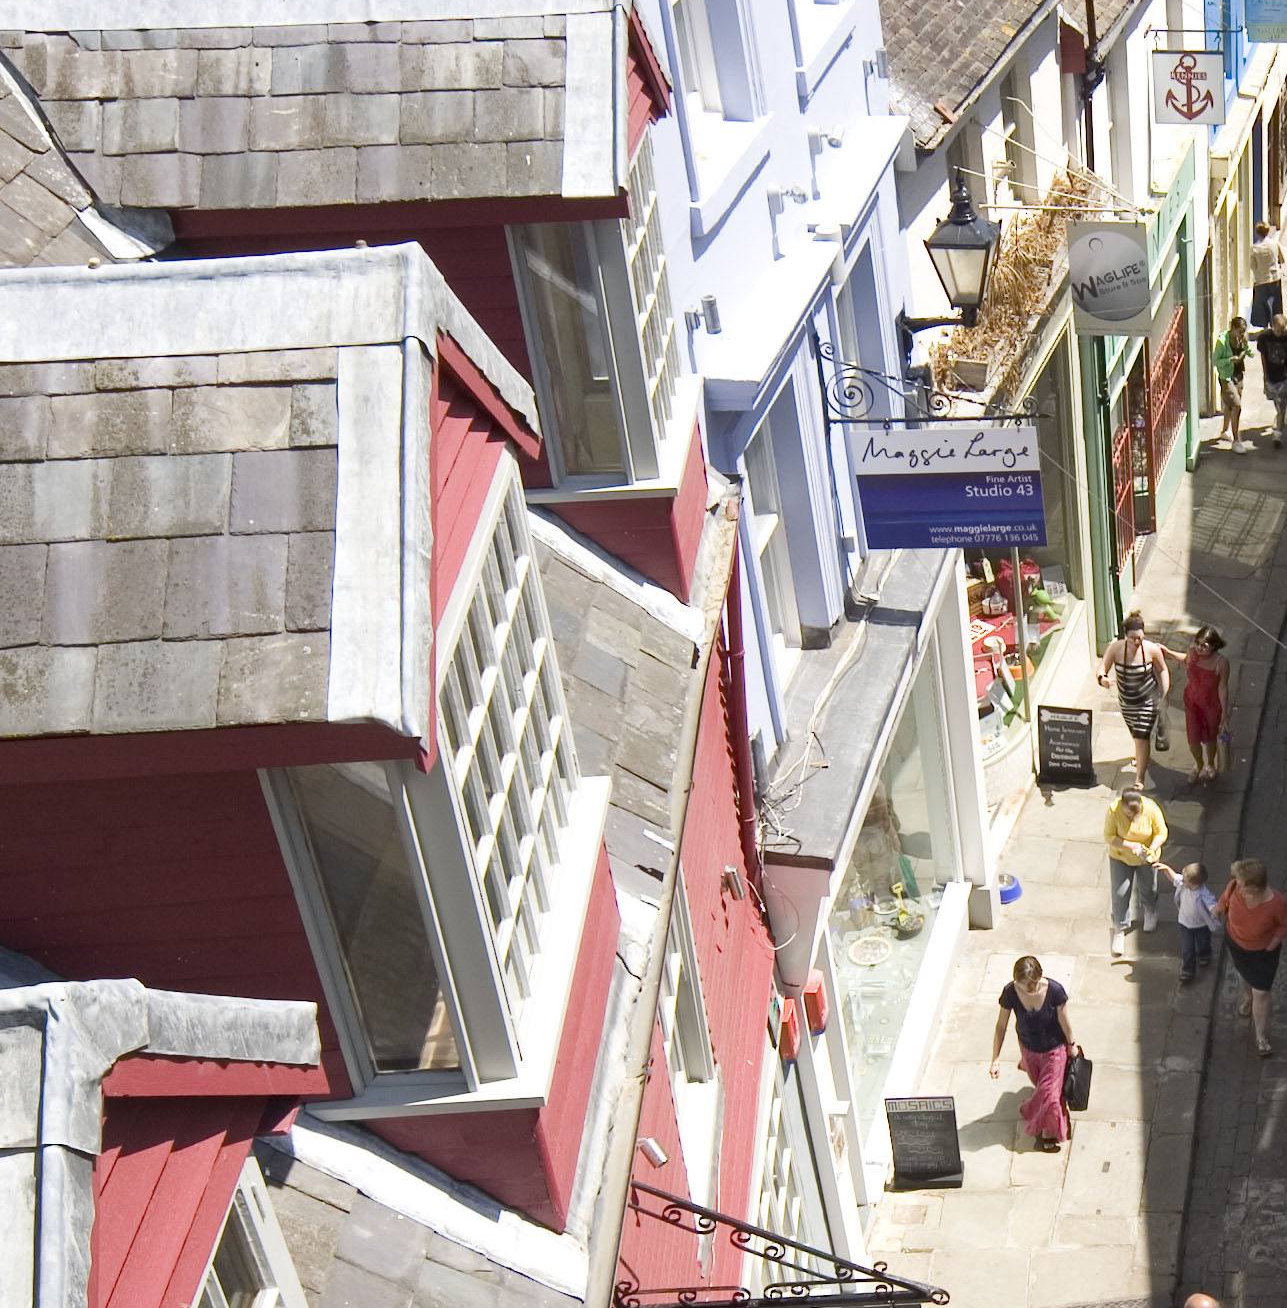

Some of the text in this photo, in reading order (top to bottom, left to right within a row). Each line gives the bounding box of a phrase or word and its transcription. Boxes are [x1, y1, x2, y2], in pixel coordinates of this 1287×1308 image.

[862, 432, 1030, 468] Maggie Large
[985, 475, 1033, 484] Fine Artist
[965, 484, 1034, 498] Studio 43
[929, 524, 1038, 536] www.maggielarge.co.uk
[931, 532, 1039, 545] telephone 07776 136 045
[887, 1099, 952, 1111] MOSAICS
